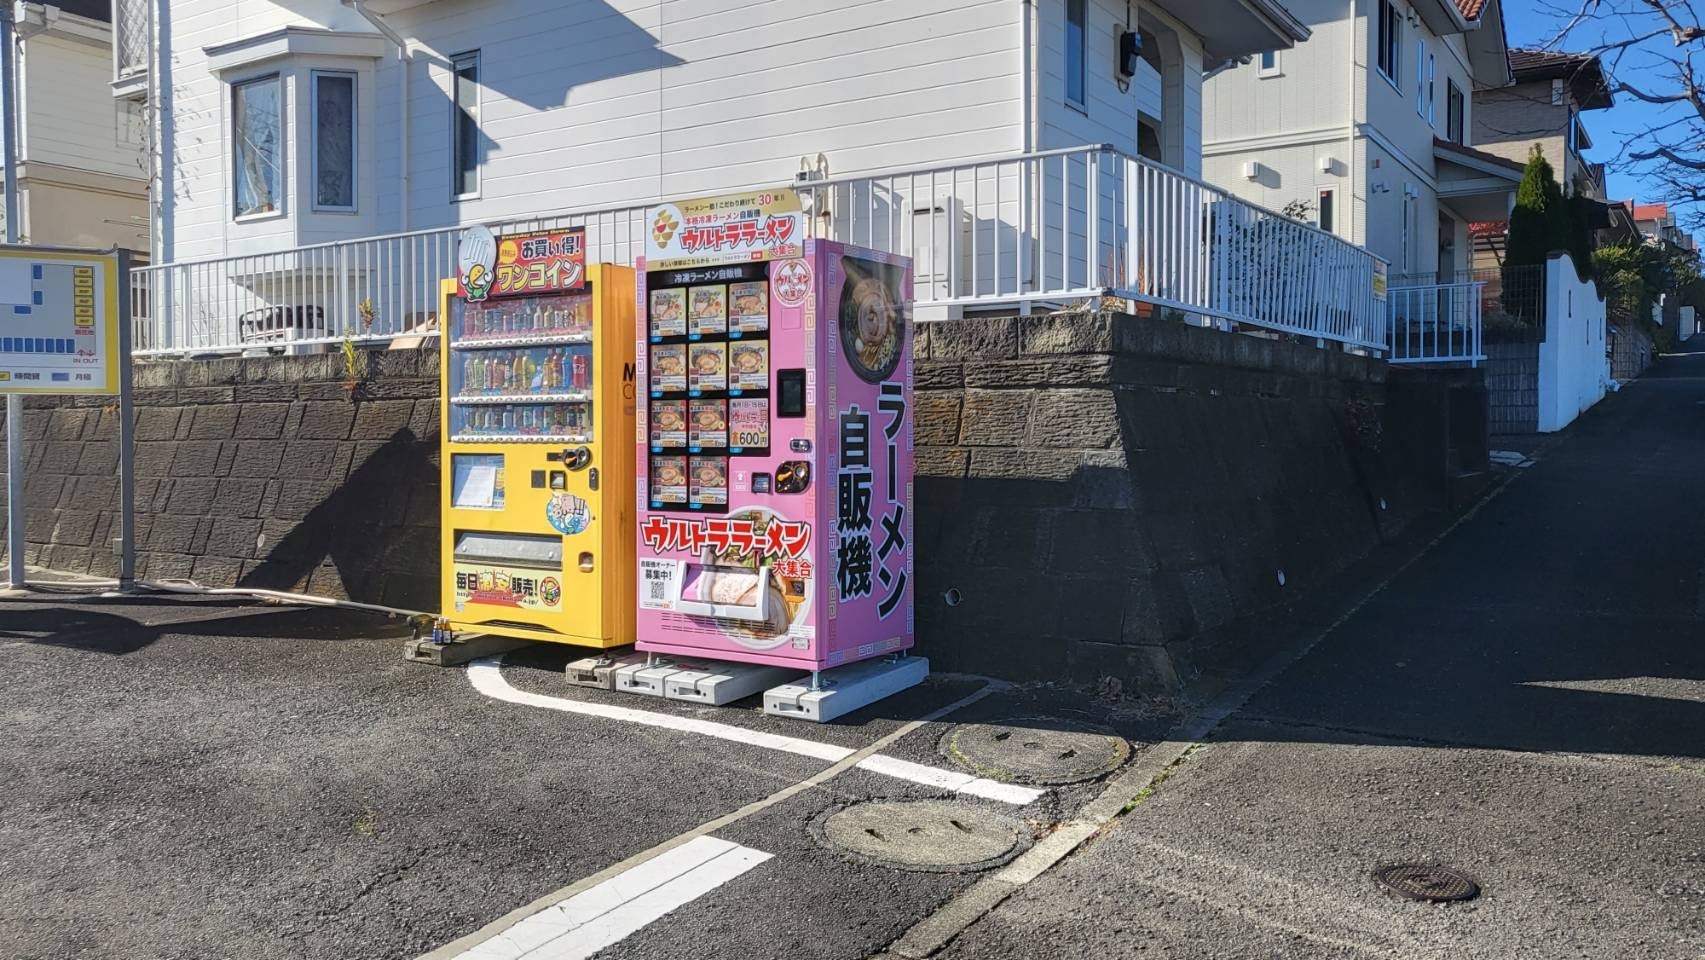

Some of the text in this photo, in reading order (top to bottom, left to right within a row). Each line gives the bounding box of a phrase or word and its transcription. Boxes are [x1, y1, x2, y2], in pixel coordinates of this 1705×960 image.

[680, 215, 795, 253] ウルトララーメン
[521, 236, 581, 259] お買い得!
[769, 242, 796, 257] 大集合
[497, 259, 581, 292] ワンコイン
[674, 268, 743, 284] 冷凍ラーメン自販機
[837, 403, 873, 602] 自販機
[878, 382, 907, 620] ラーメン
[640, 515, 811, 559] ウルトララーメン
[641, 560, 676, 569] 自販機オーナー
[645, 569, 672, 581] 募集中!
[772, 559, 812, 578] 大集合
